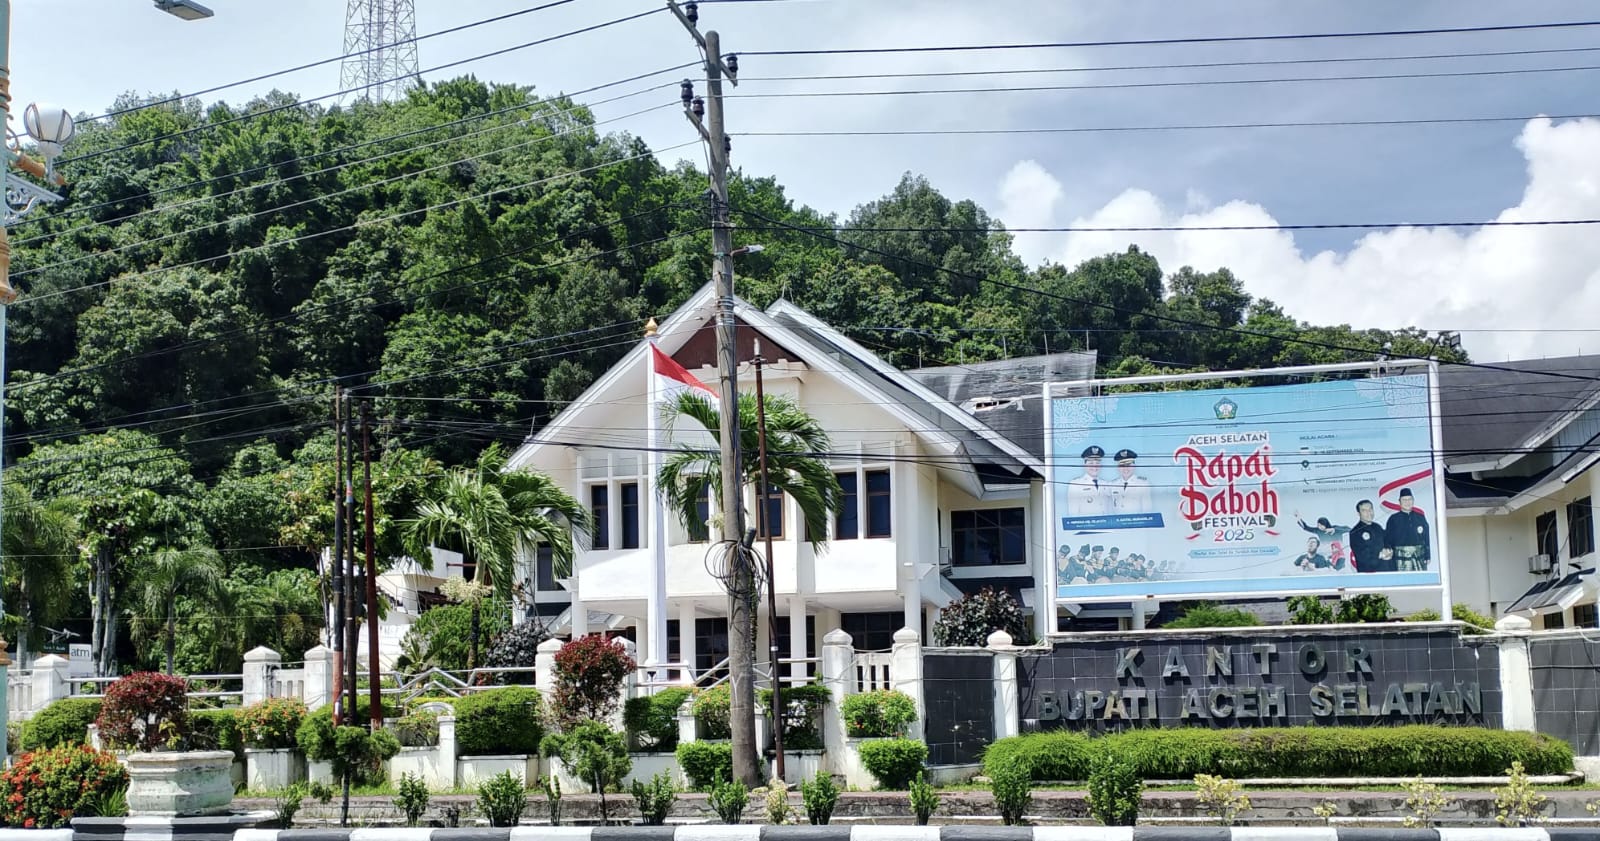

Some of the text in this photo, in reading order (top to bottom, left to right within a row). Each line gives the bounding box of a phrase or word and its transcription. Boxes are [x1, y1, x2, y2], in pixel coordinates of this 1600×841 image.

[1188, 432, 1268, 445] ACEH SELATAN
[1174, 446, 1276, 488] Rapai
[1180, 480, 1279, 521] Daboh
[1205, 515, 1266, 528] FESTIVAL
[1214, 529, 1255, 542] 2025
[70, 647, 90, 657] atm
[1116, 642, 1374, 678] KANTOR
[1037, 681, 1482, 721] BUPATI ACEH SELATAN
